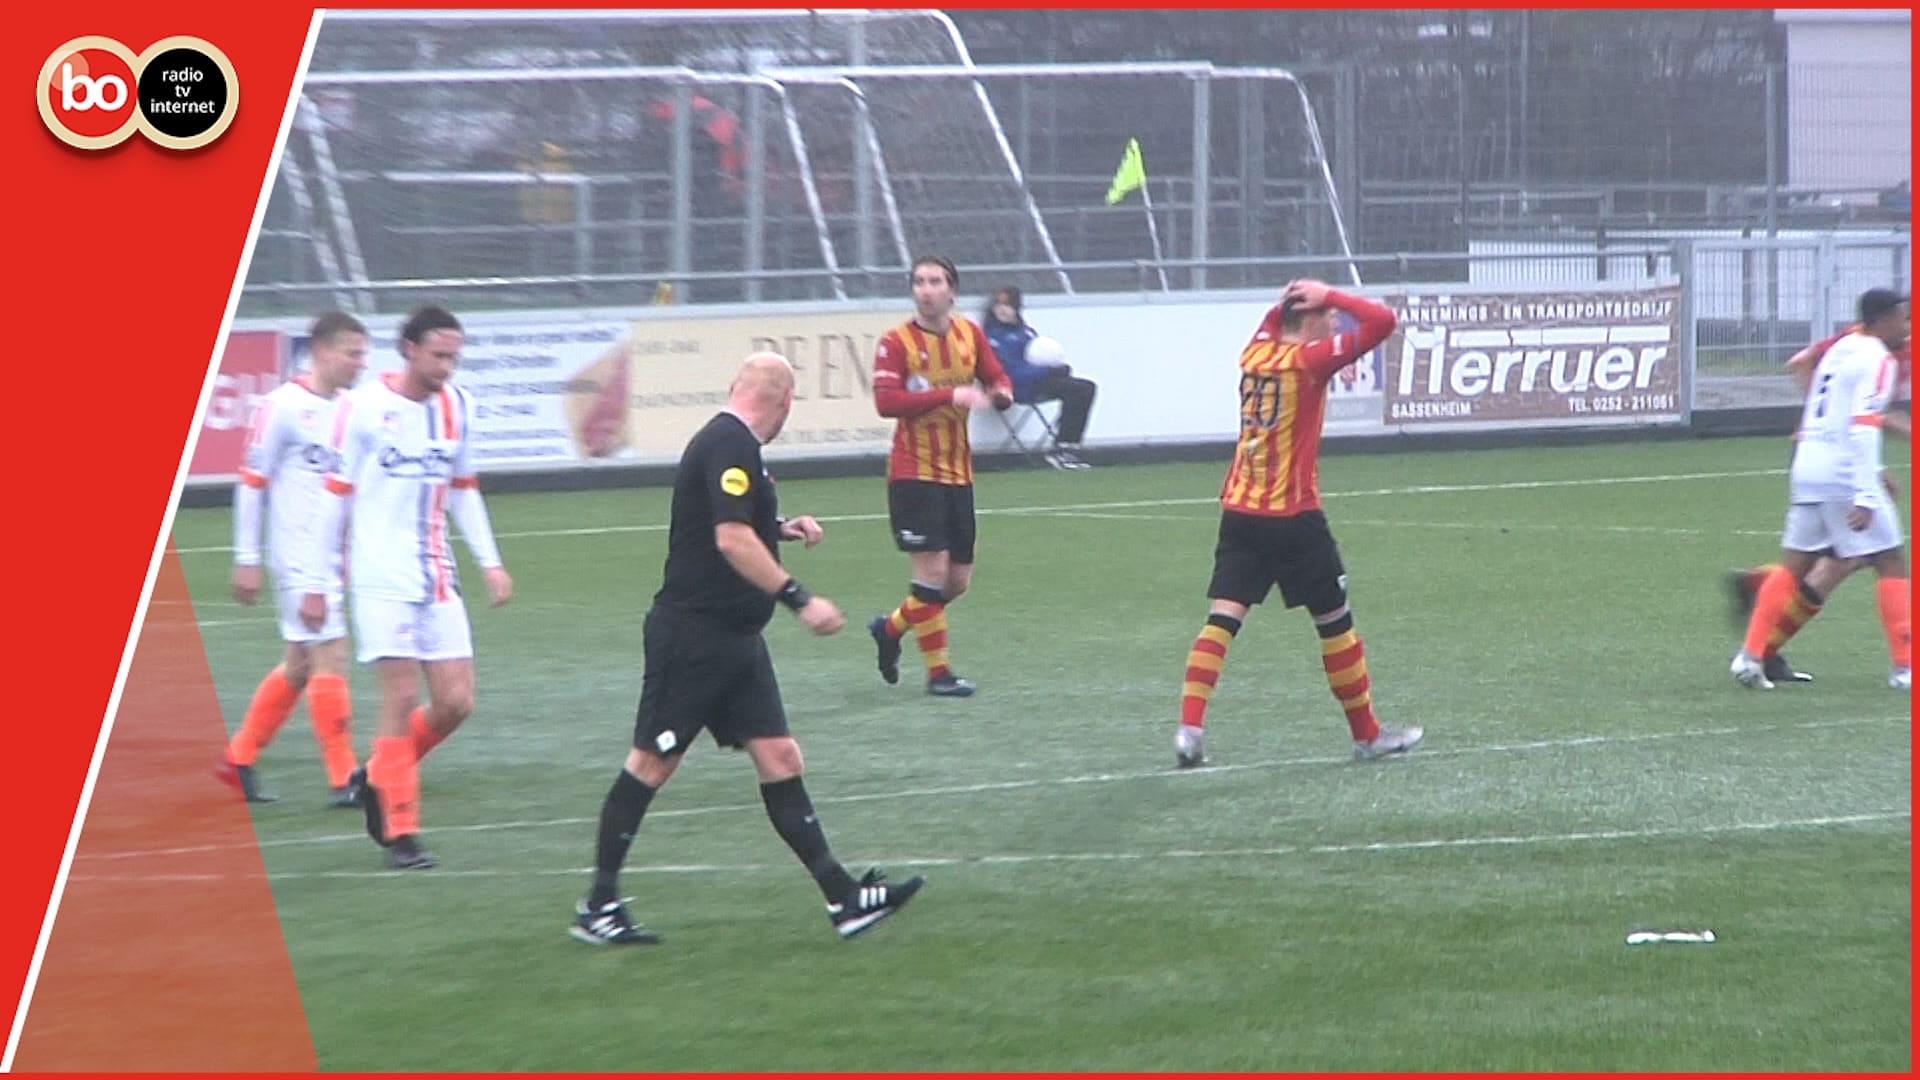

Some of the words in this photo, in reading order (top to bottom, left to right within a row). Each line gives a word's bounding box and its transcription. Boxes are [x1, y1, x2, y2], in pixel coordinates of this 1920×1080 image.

[1503, 304, 1523, 321] EN
[1527, 301, 1672, 320] TRANSPORTBEDRIJF
[1398, 325, 1668, 397] Herruer
[1391, 400, 1472, 418] SASSENHEIM
